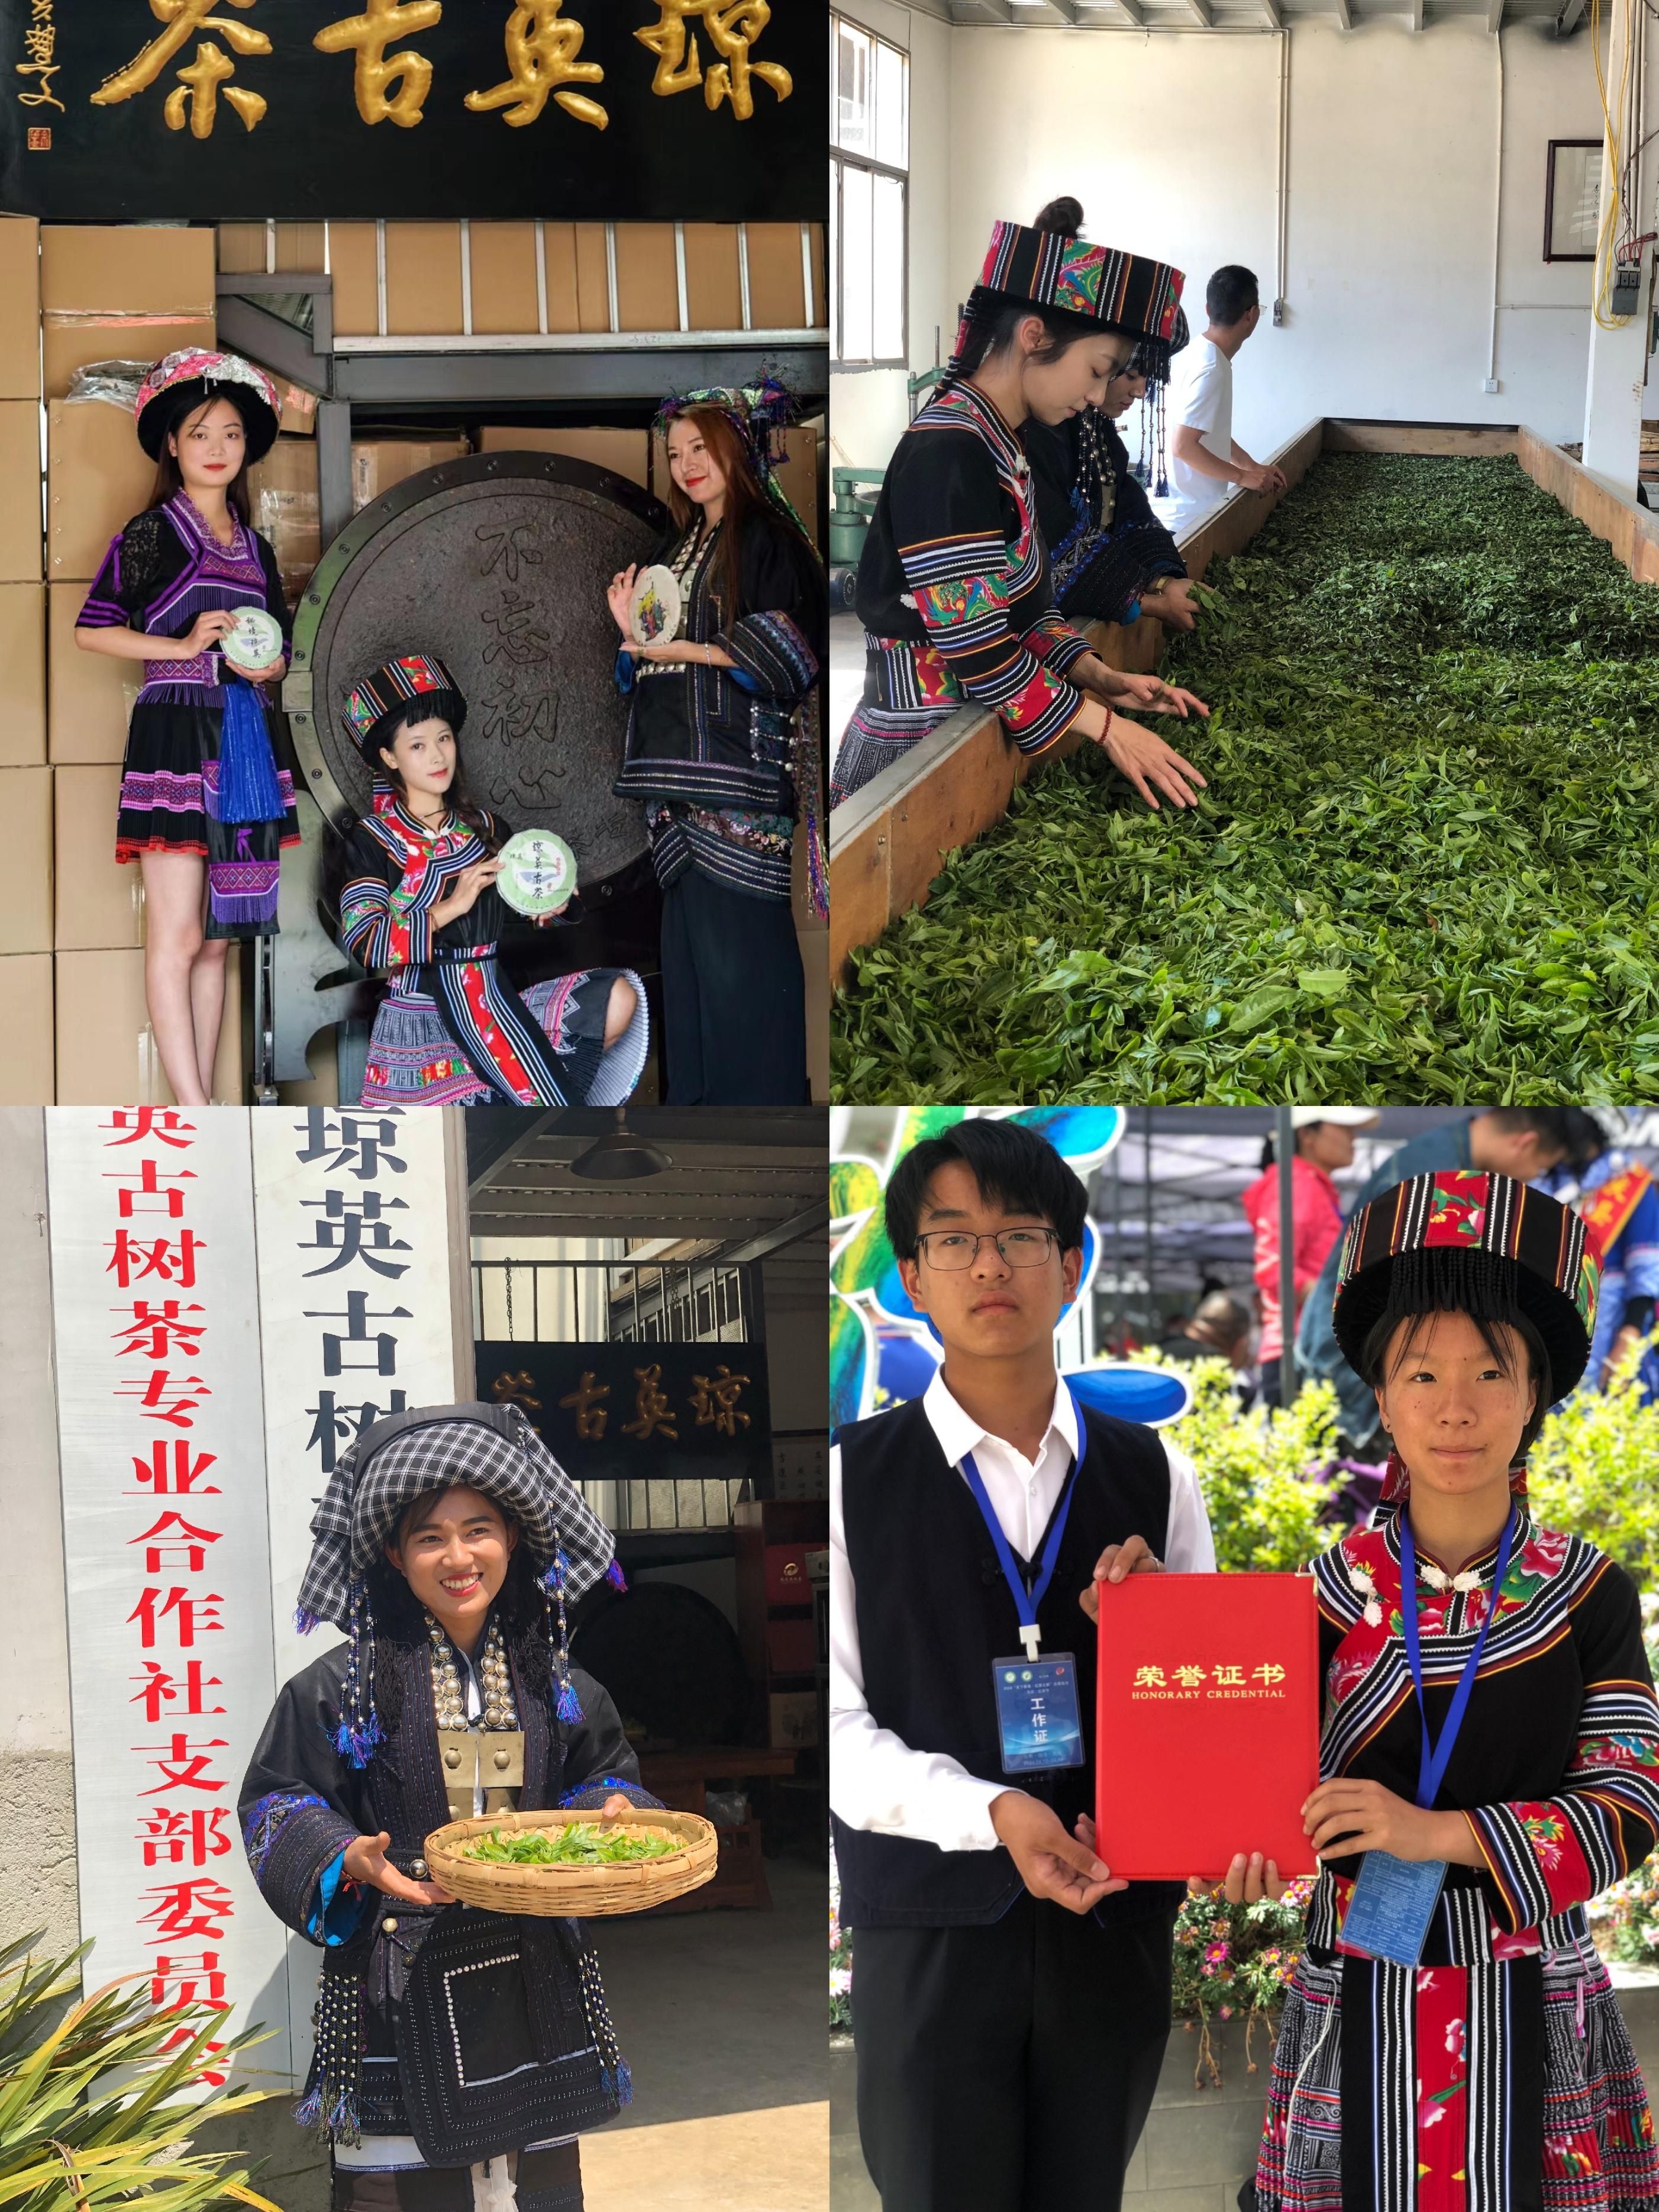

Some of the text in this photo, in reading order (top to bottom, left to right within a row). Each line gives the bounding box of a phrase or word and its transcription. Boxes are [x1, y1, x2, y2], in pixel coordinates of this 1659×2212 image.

[475, 518, 566, 810] 不忘初心
[293, 1106, 415, 1504] 琼英古树
[1132, 1689, 1286, 1700] HONORARY CREDENTIAL
[1133, 1663, 1286, 1687] 荣誉证书
[1031, 1698, 1048, 1743] 工作证
